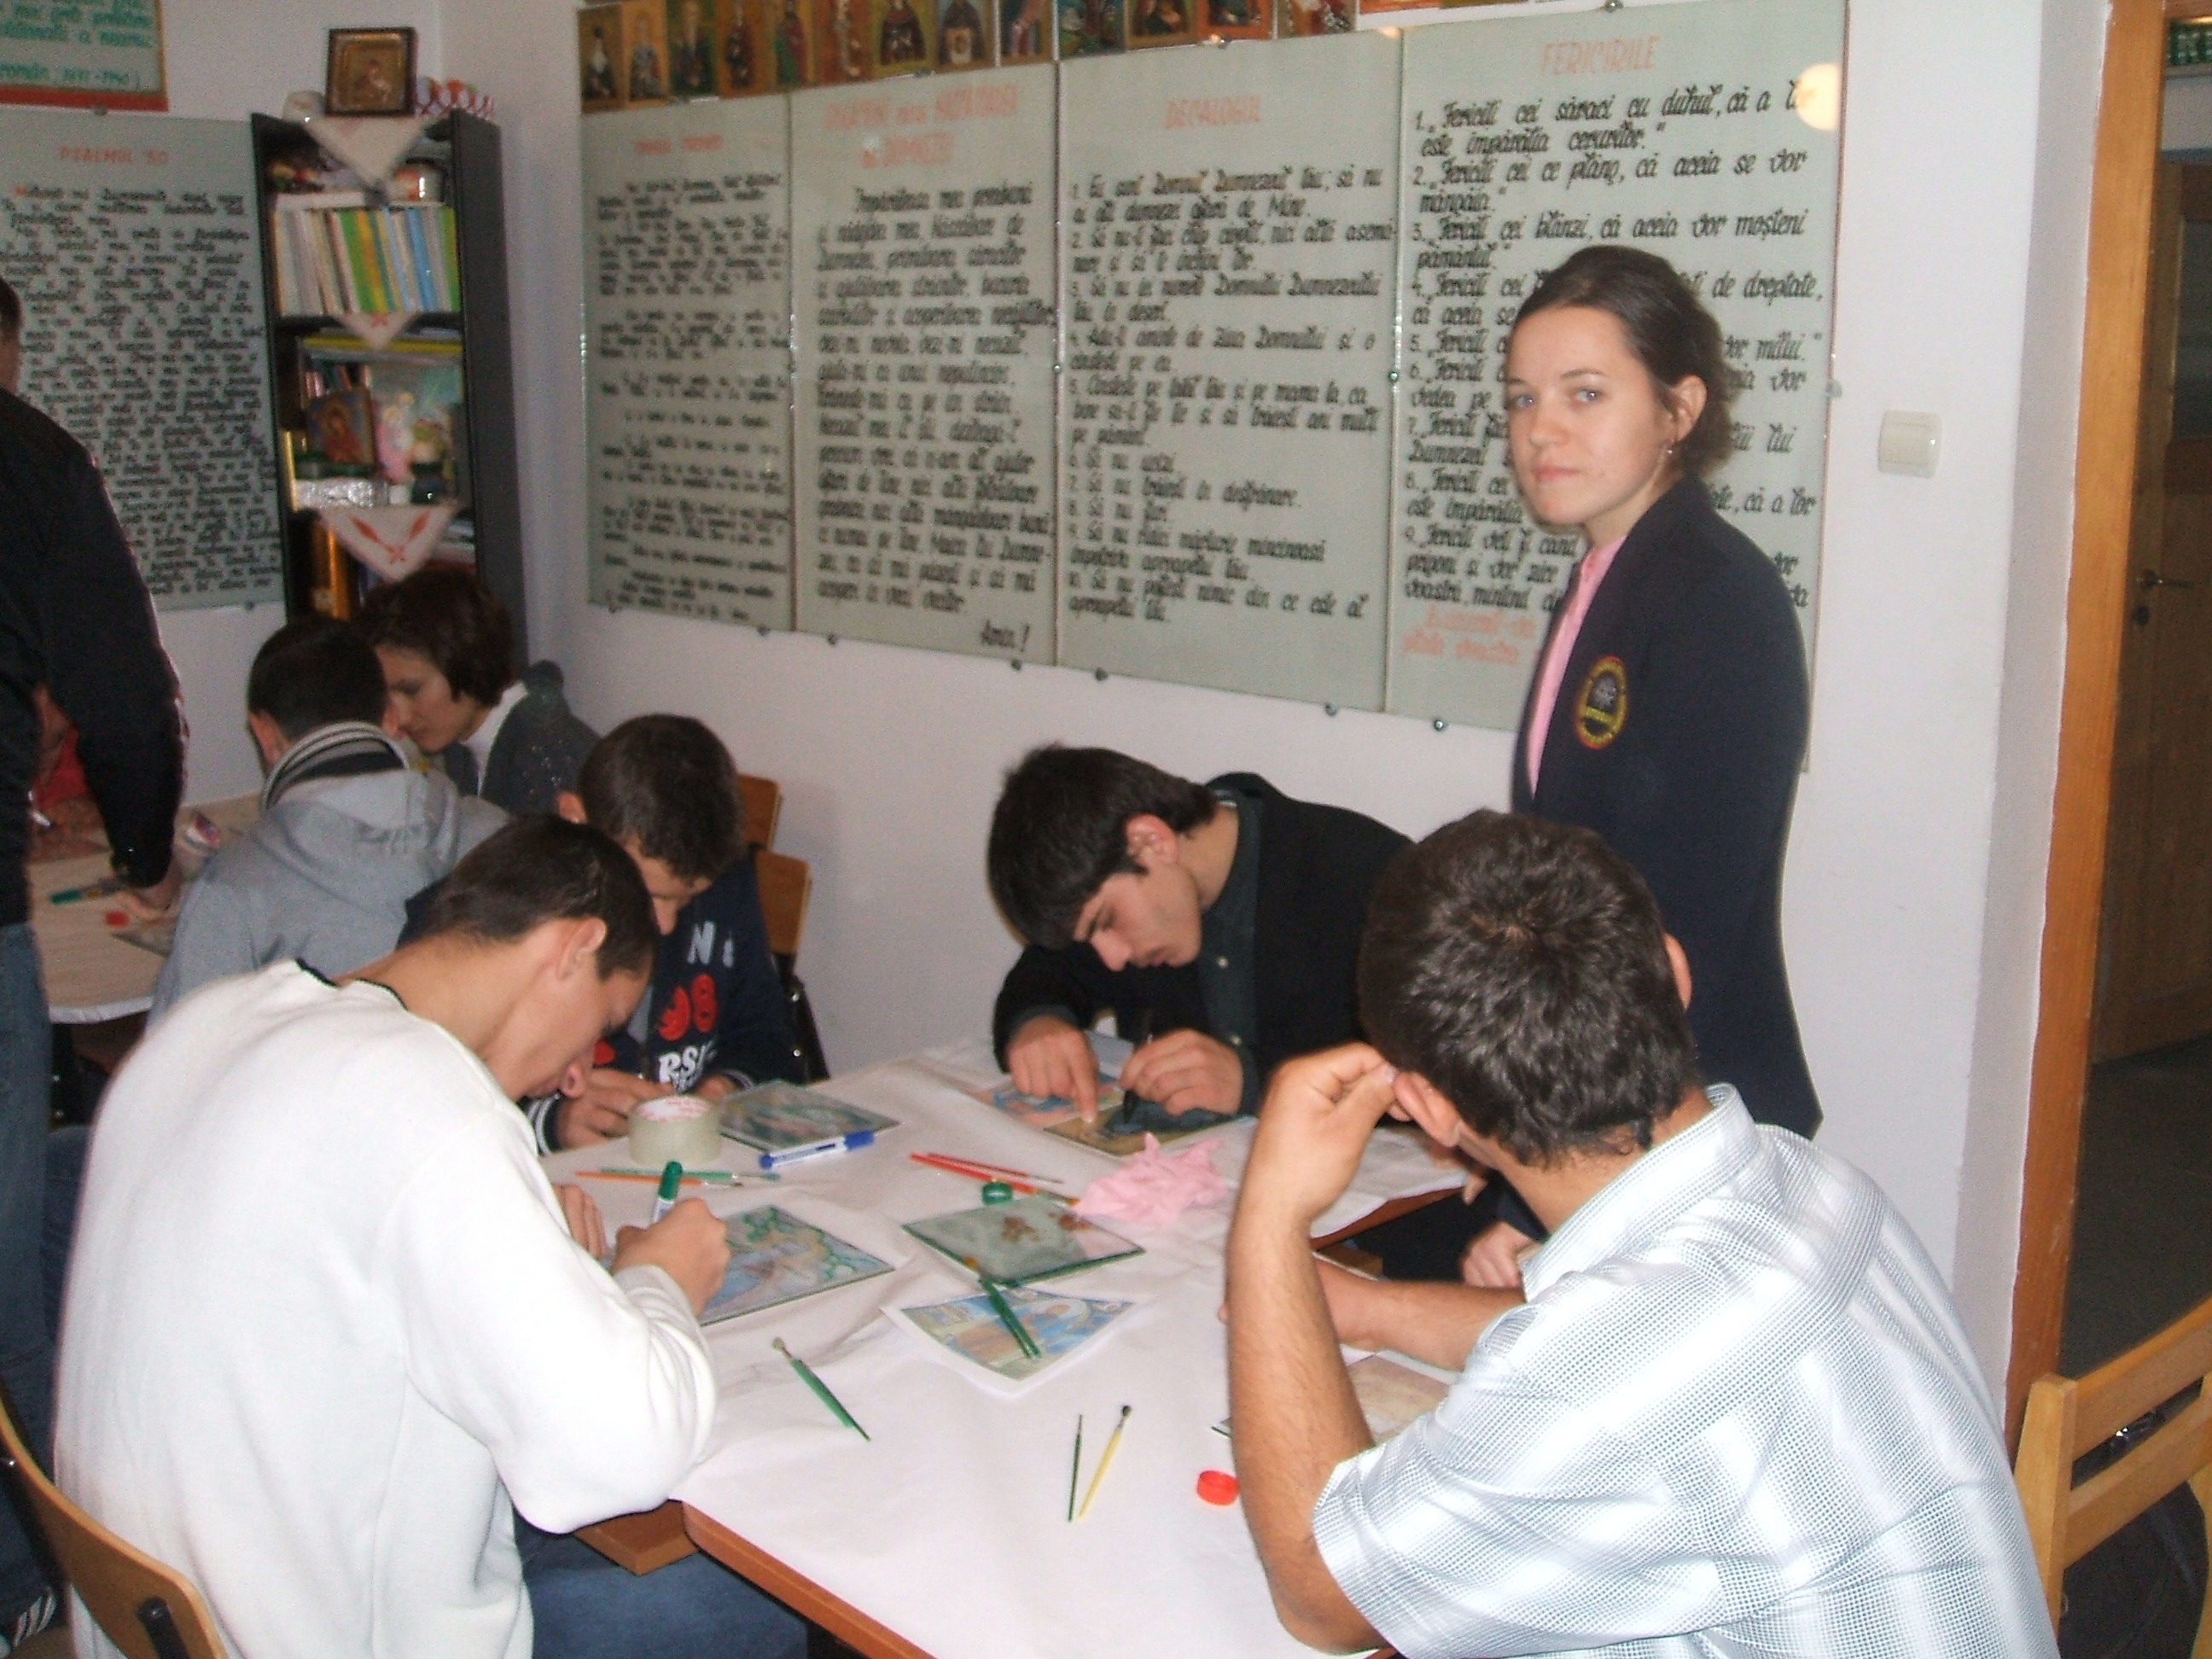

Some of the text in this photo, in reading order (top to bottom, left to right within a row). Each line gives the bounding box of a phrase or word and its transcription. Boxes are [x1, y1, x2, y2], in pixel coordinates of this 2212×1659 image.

[1516, 98, 1543, 125] cei
[1627, 96, 1651, 119] cu
[1756, 90, 1772, 112] a
[1507, 154, 1533, 182] cei
[1541, 160, 1562, 182] ce
[1674, 148, 1722, 177] aceia
[1733, 154, 1756, 175] se
[1770, 148, 1808, 173] vor
[1500, 214, 1528, 241] cei
[1632, 210, 1679, 238] aceia
[1691, 212, 1730, 238] vor
[1500, 272, 1528, 297] cei
[1712, 271, 1737, 299] de
[1770, 366, 1807, 392] vor
[1772, 495, 1784, 514] a
